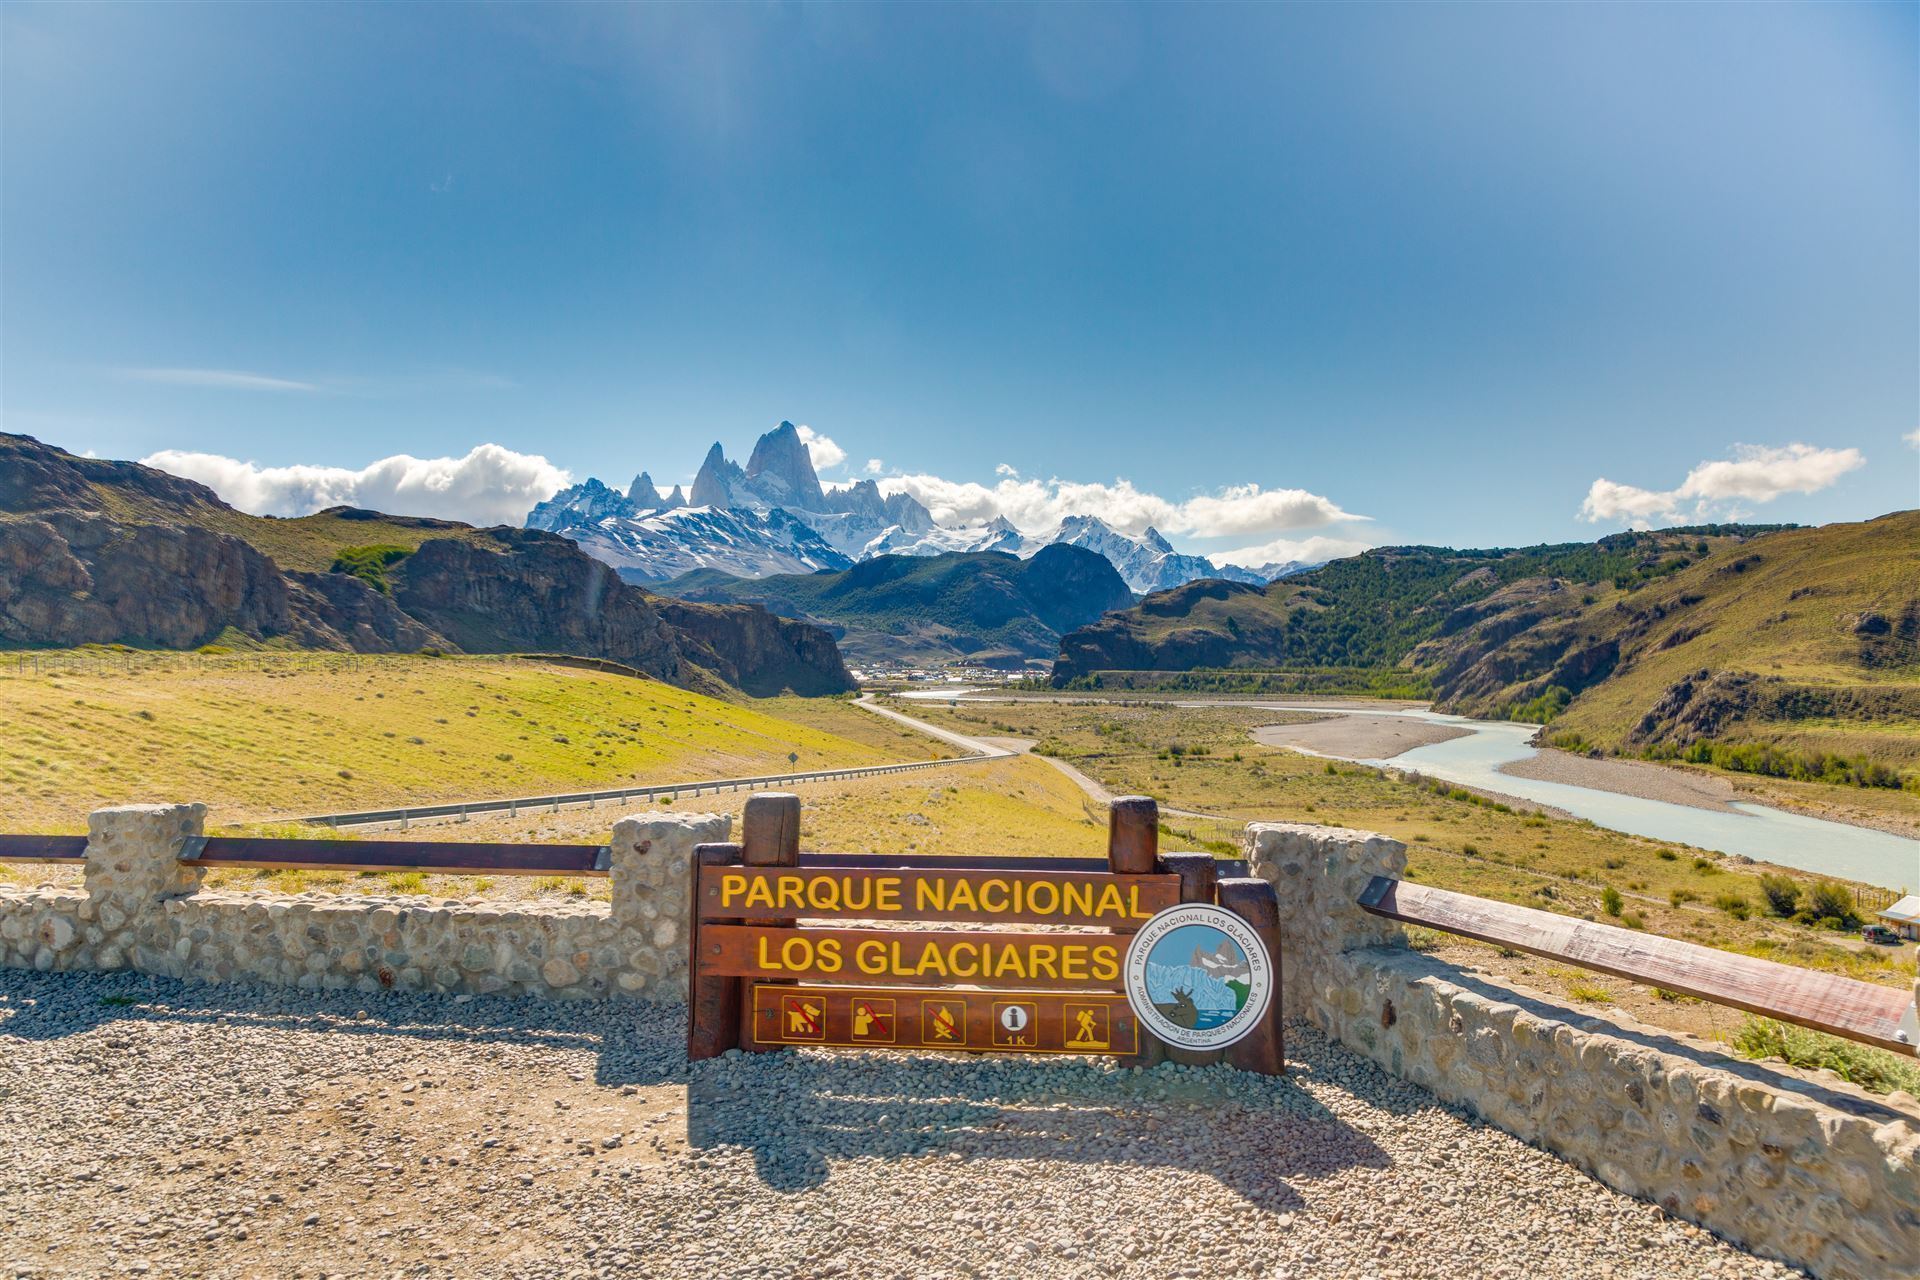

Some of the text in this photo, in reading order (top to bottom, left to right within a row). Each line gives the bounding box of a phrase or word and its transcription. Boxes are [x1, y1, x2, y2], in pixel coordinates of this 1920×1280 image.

[721, 874, 1154, 919] PARQUE NACIONAL
[758, 935, 1119, 981] LOS GLACIARES
[1134, 914, 1262, 972] PARQUE NACIONAL LOS GLACIARES
[1180, 1030, 1191, 1038] DE
[1191, 1027, 1227, 1038] PARQUES
[1226, 992, 1258, 1031] NACIONALES
[1176, 1036, 1212, 1044] ARGENTINA
